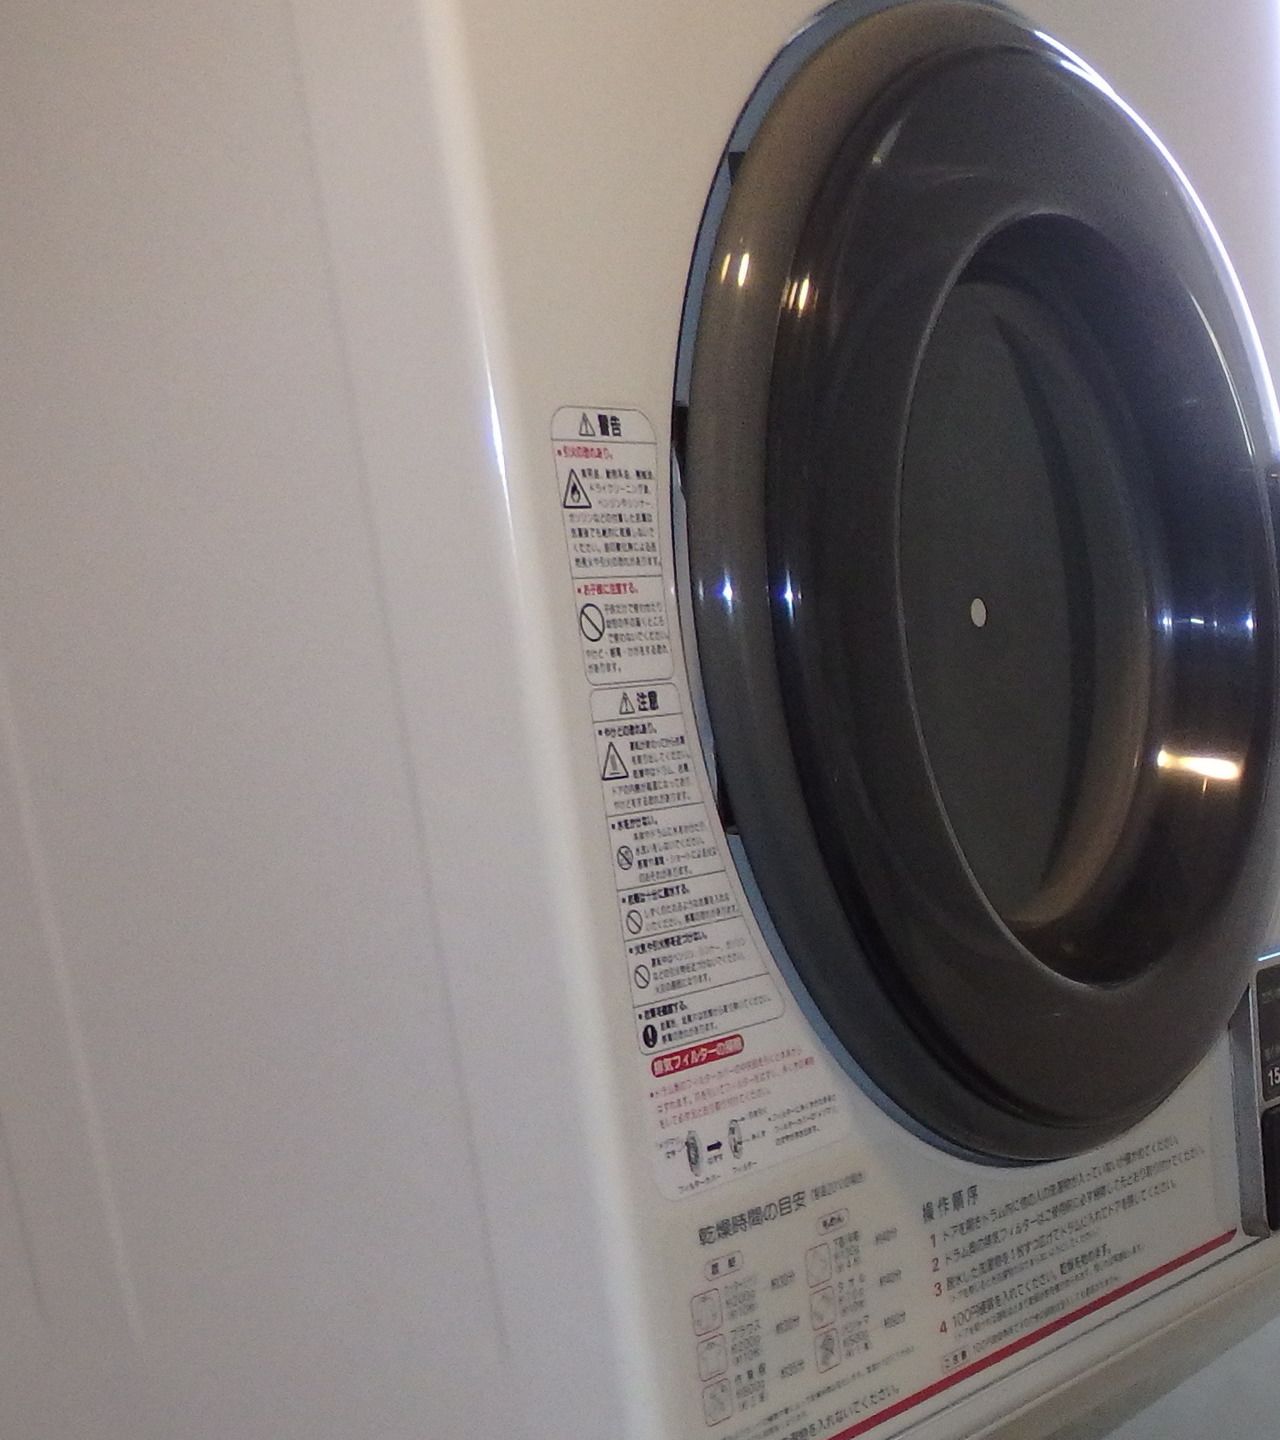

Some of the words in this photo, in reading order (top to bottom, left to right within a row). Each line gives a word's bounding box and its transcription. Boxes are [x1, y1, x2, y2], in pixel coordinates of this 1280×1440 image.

[1268, 1067, 1280, 1086] 15
[929, 1233, 937, 1249] 1
[931, 1257, 940, 1273] 2
[934, 1281, 943, 1297] 3
[939, 1320, 948, 1334] 4
